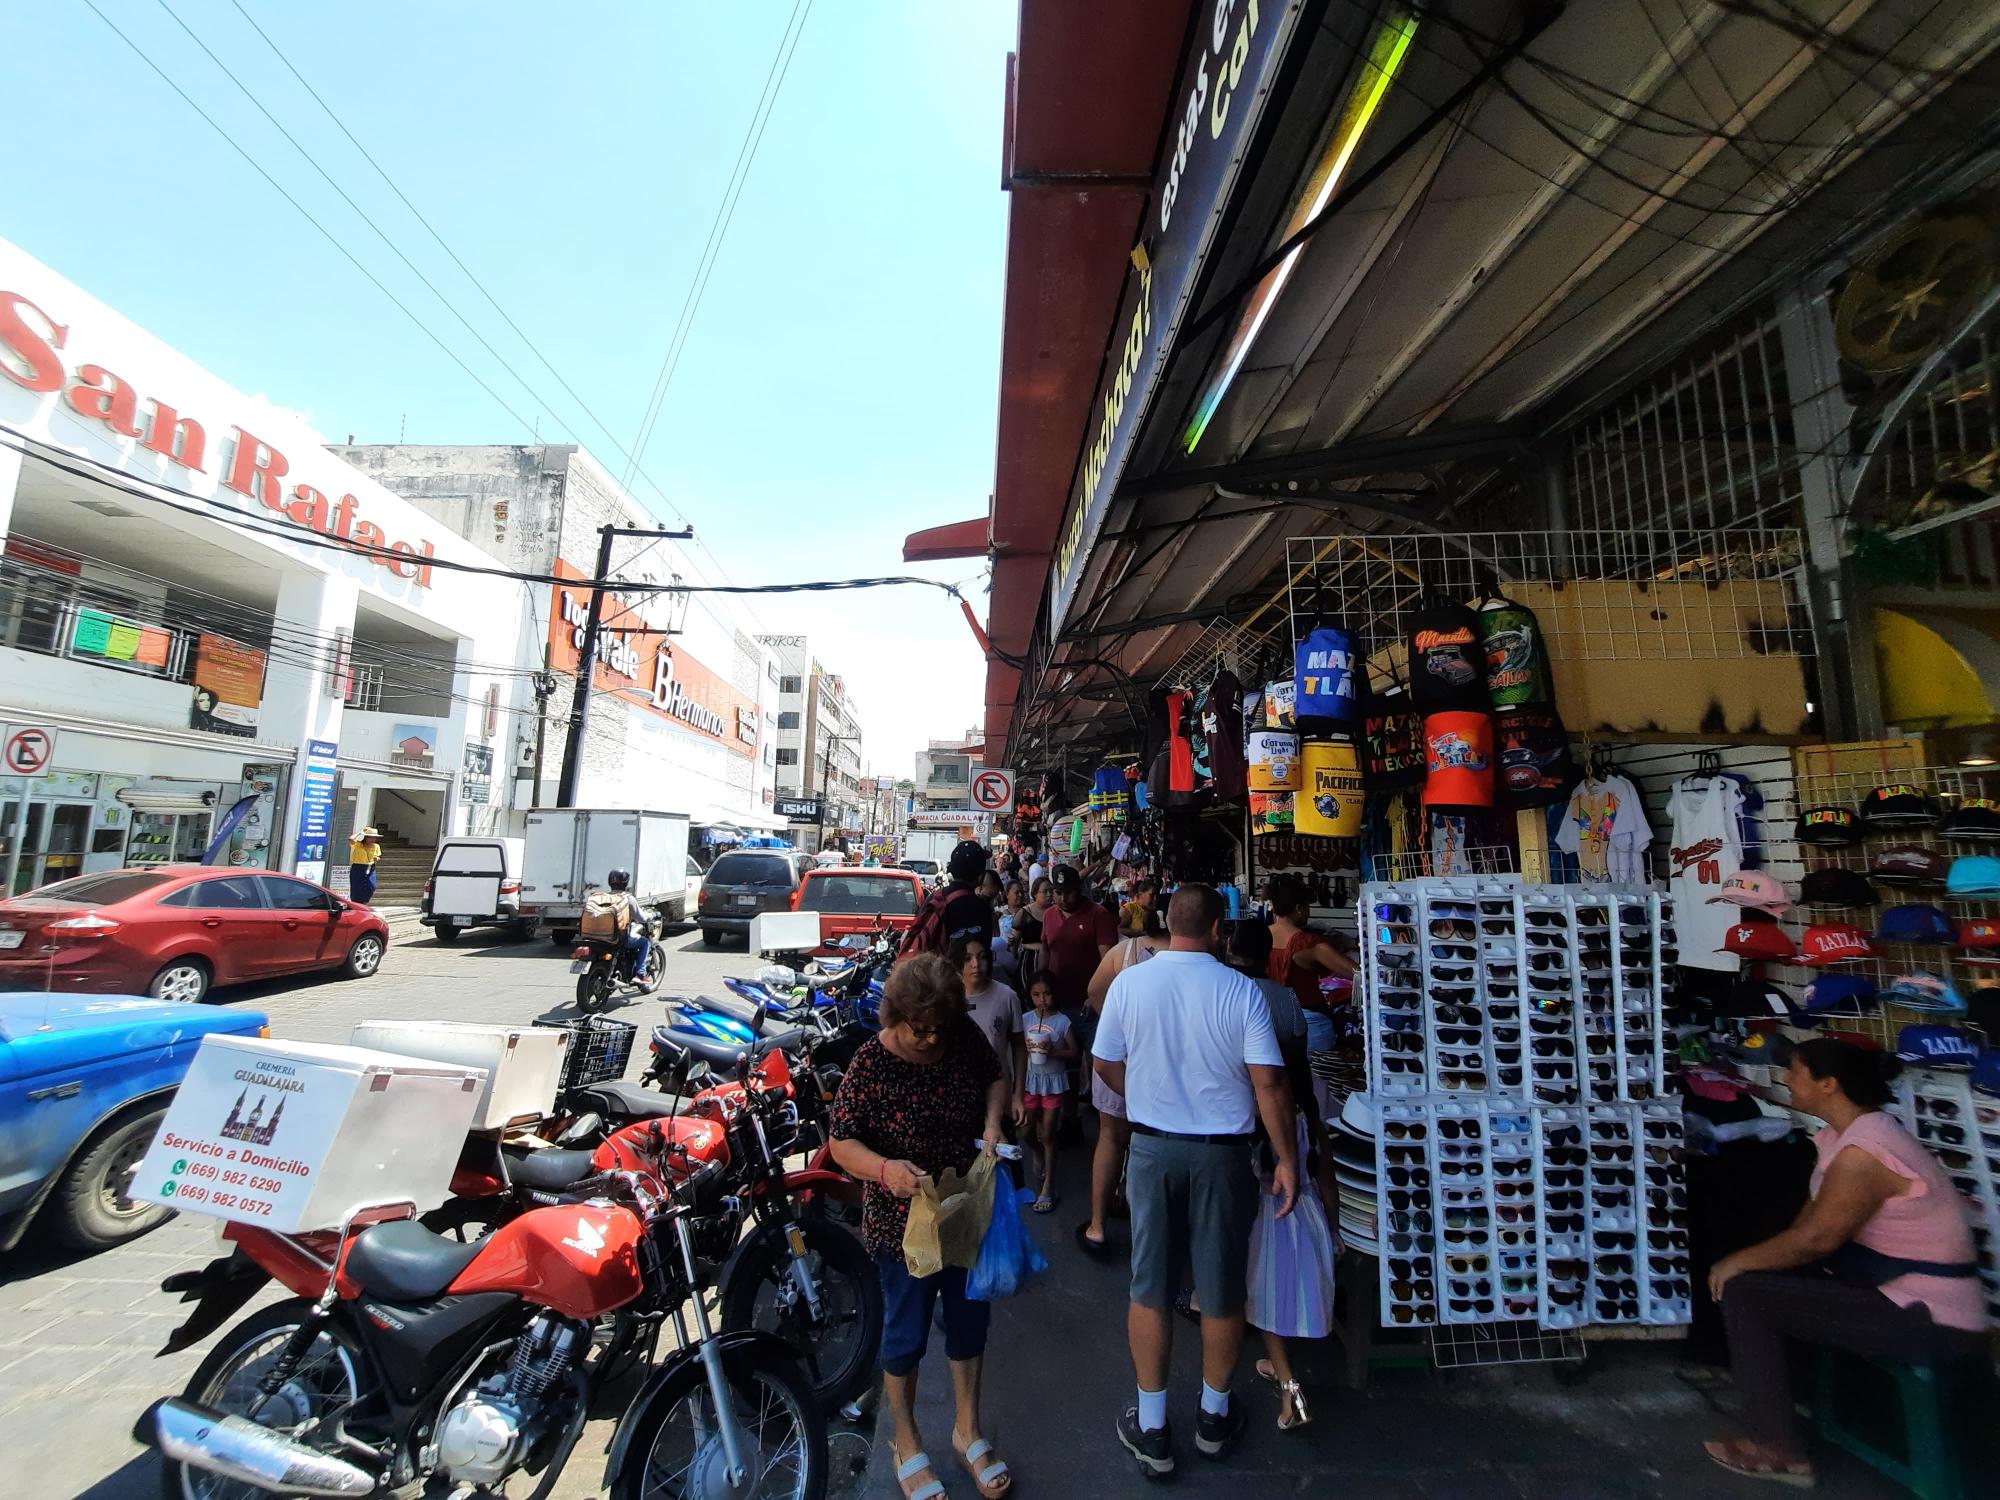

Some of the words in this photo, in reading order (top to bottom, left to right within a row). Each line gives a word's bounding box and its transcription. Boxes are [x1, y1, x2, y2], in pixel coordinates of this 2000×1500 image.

[1161, 49, 1208, 232] estas
[0, 290, 207, 475] San
[225, 424, 433, 591] Rafael
[1697, 859, 1720, 885] 01
[234, 1069, 305, 1093] GUADALAJARA
[163, 1132, 223, 1157] Servicio
[226, 1148, 237, 1160] a
[240, 1149, 310, 1177] Domicilio
[186, 1161, 219, 1182] (669)
[222, 1169, 247, 1186] 982
[250, 1176, 282, 1194] 6290
[175, 1183, 210, 1204] (669)
[211, 1191, 238, 1207] 982
[239, 1198, 273, 1216] 0572
[532, 1191, 559, 1205] YAMAHA
